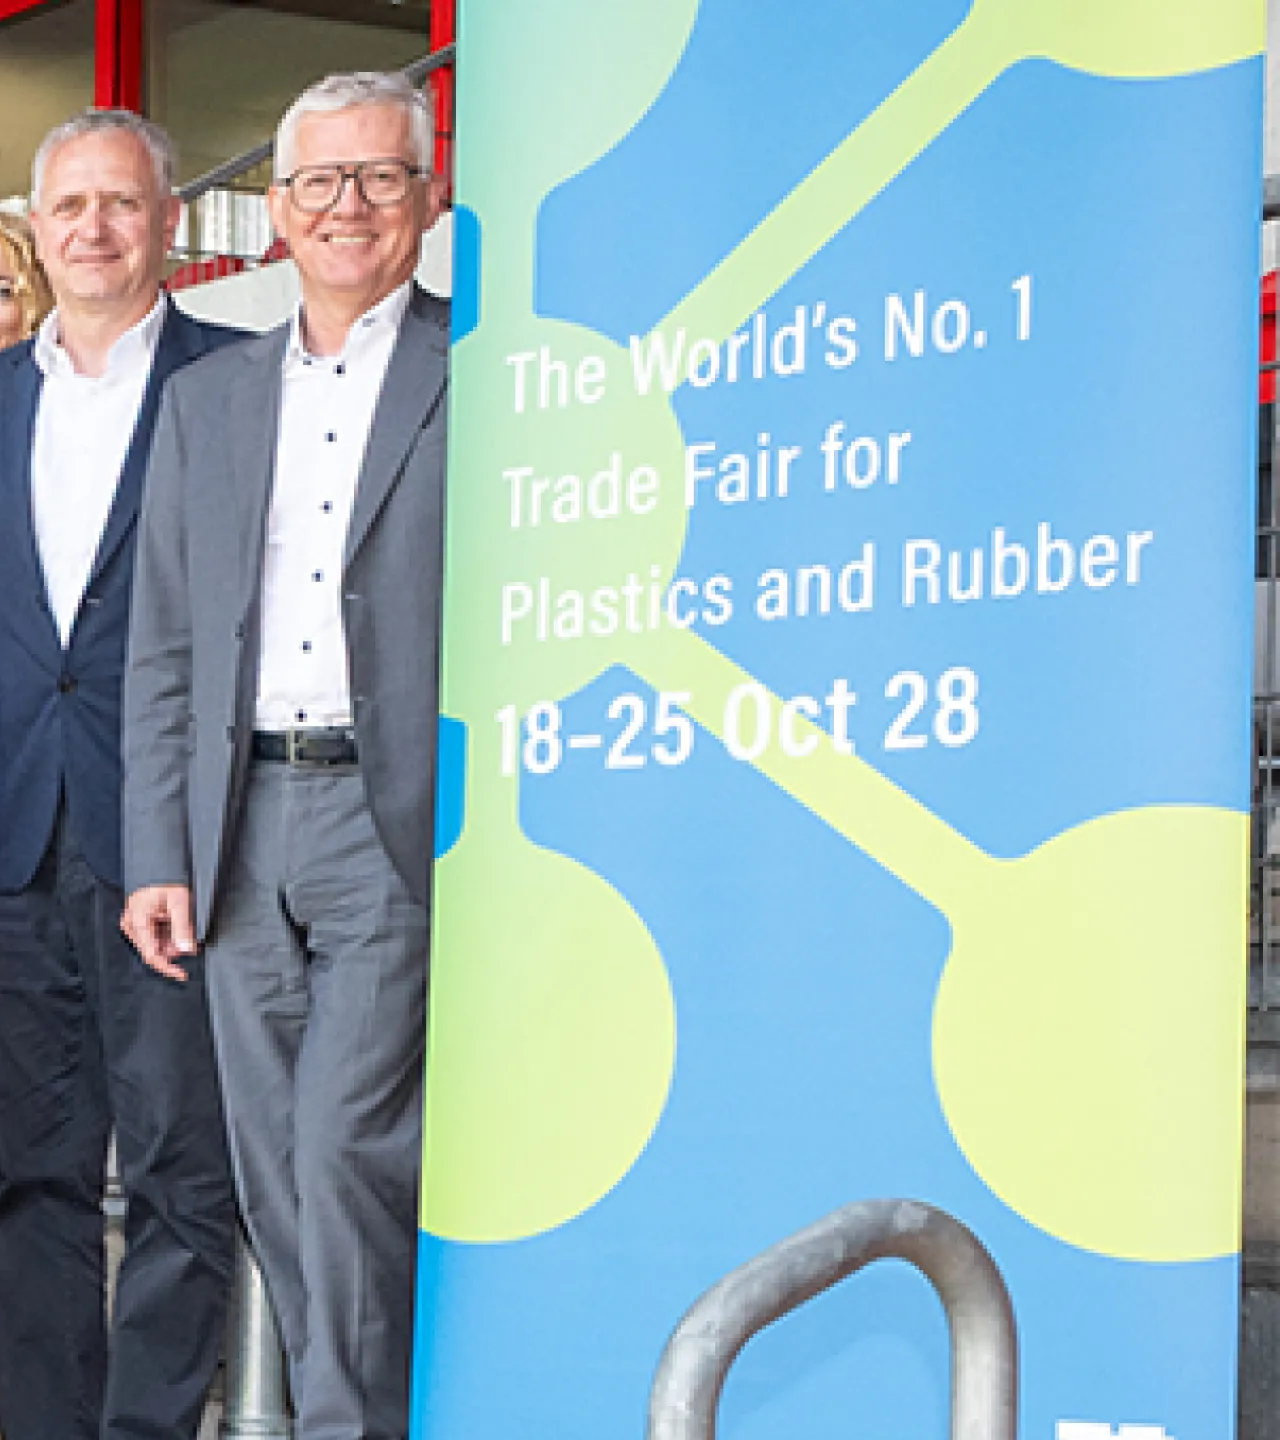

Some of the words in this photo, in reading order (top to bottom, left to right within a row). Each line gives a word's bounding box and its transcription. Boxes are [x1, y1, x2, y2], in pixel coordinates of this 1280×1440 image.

[506, 345, 607, 413] The
[629, 301, 858, 397] World's
[883, 289, 988, 362] No.
[1011, 275, 1032, 340] 1
[503, 452, 660, 528] Trade
[685, 432, 800, 508] Fair
[820, 421, 911, 492] for
[501, 565, 734, 645] Plastics
[756, 543, 875, 620] and
[901, 523, 1153, 607] Rubber
[723, 680, 857, 762] Oct
[883, 666, 980, 753] 28
